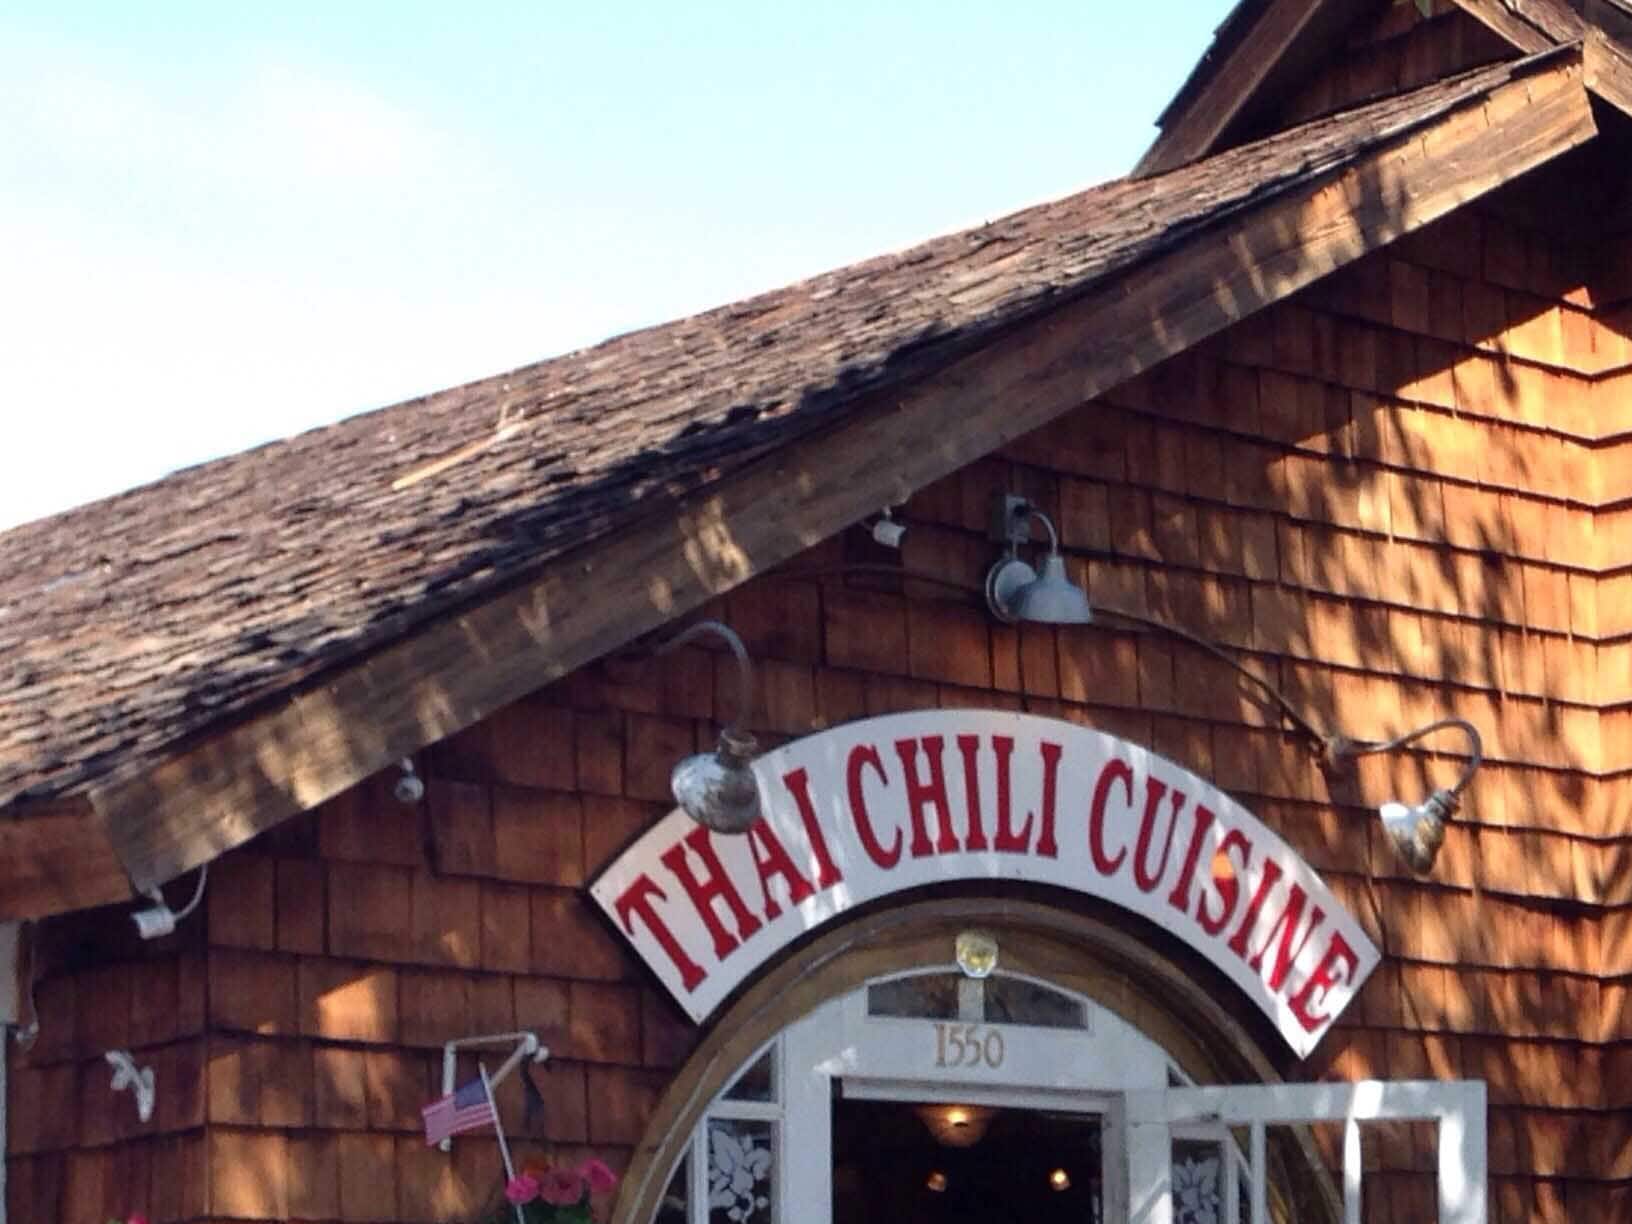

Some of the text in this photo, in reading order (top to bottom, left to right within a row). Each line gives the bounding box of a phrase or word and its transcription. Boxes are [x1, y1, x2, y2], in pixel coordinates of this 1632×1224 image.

[615, 734, 1359, 1034] THAI CHILI CUISINE
[933, 1023, 1005, 1070] 1550
